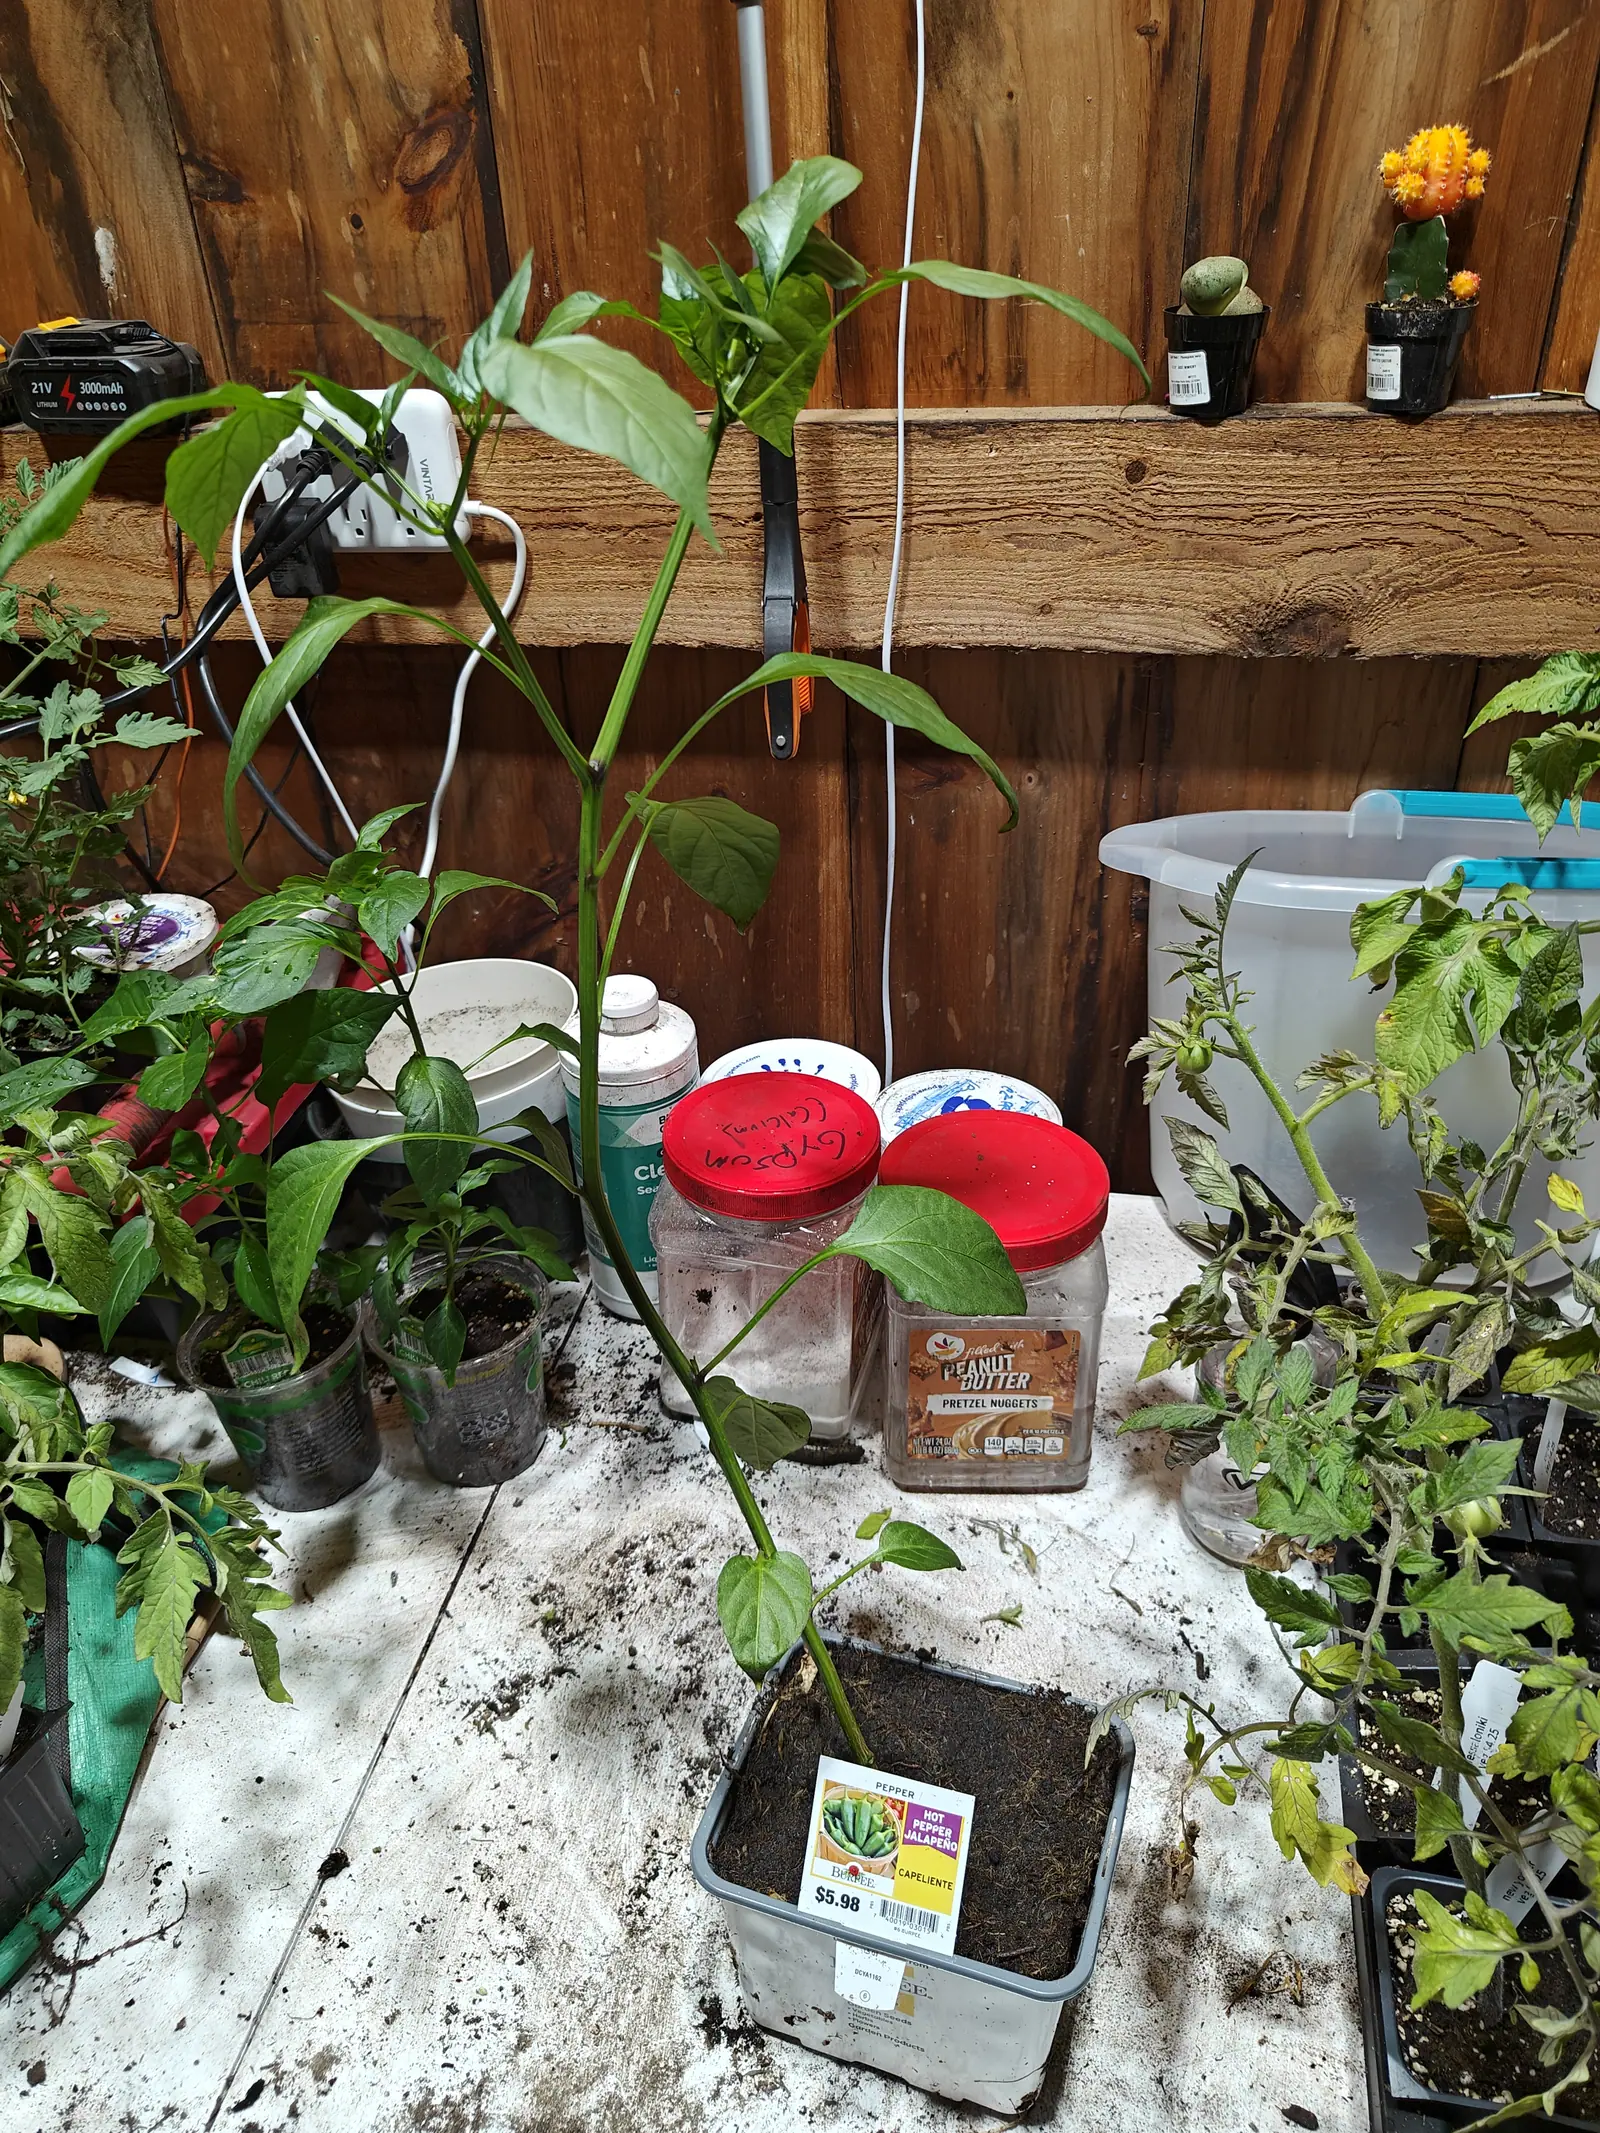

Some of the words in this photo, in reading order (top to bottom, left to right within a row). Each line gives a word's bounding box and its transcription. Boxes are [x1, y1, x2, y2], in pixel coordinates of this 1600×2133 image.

[31, 382, 52, 394] 21V
[80, 382, 123, 395] 3000mAh
[960, 1372, 1031, 1391] BUTTER
[942, 1399, 986, 1409] PRETZEL
[990, 1398, 1038, 1409] NUGGETS
[987, 1438, 1002, 1446] 140
[875, 1781, 915, 1799] PEPPER
[923, 1809, 945, 1824] HOT
[912, 1818, 953, 1839] PEPPER
[904, 1829, 958, 1853] JALAPEÑO
[898, 1868, 954, 1891] CAPELIENTE
[814, 1886, 860, 1912] $5.98
[852, 2008, 893, 2025] Vegetables
[884, 2011, 912, 2026] Seeds
[848, 2022, 882, 2038] Garden
